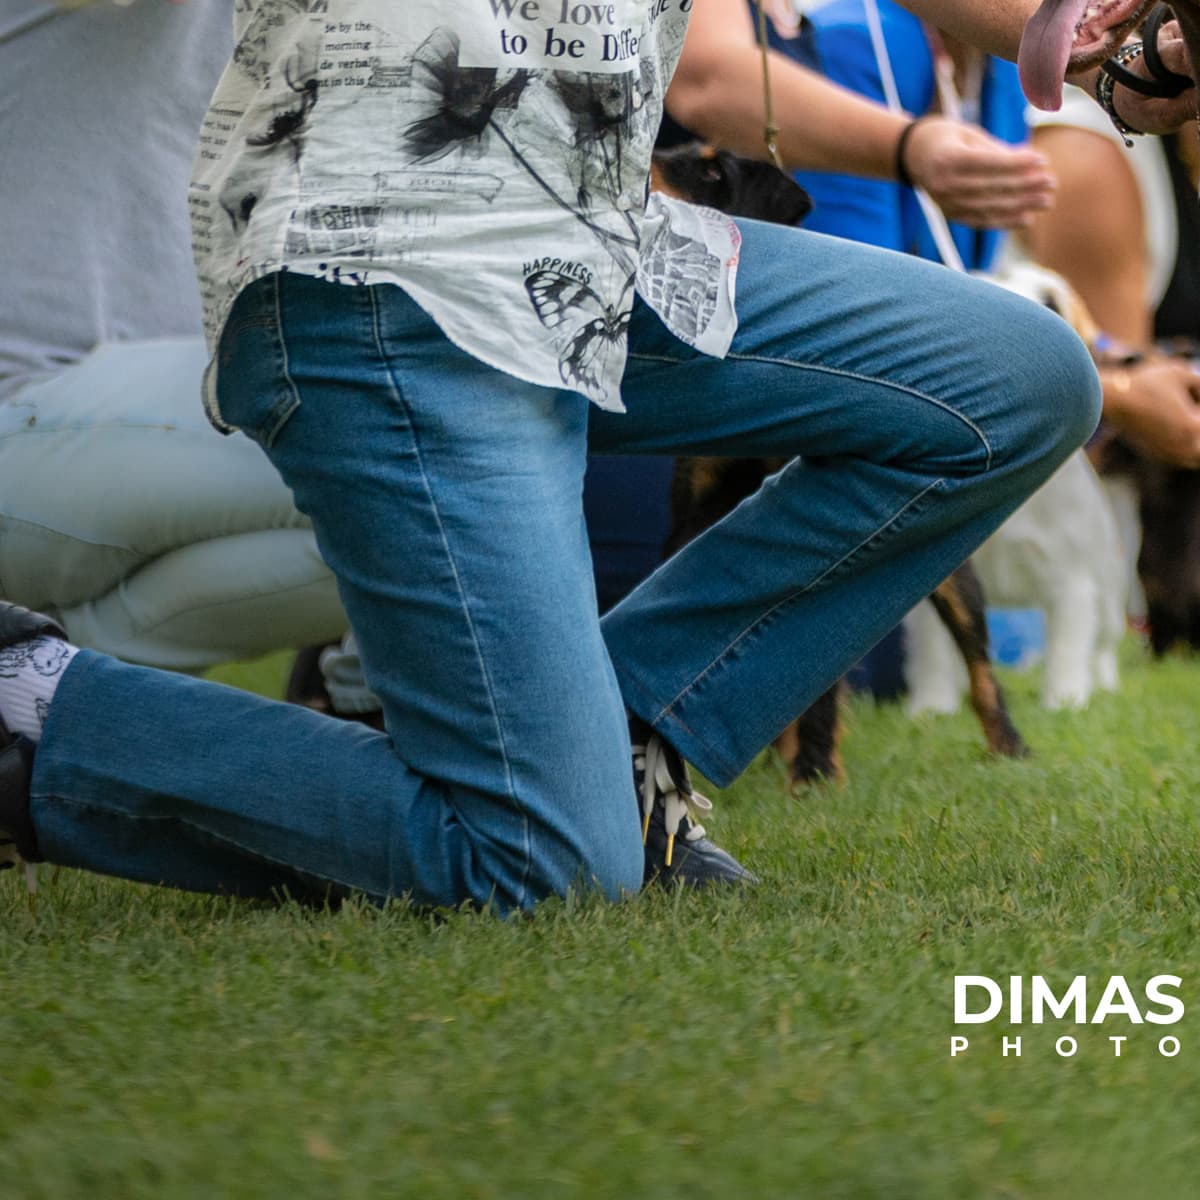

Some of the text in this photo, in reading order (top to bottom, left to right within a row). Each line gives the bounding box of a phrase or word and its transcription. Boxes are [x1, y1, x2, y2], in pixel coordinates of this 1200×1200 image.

[499, 28, 528, 55] to
[544, 28, 586, 58] be
[522, 256, 594, 285] HAPPINESS
